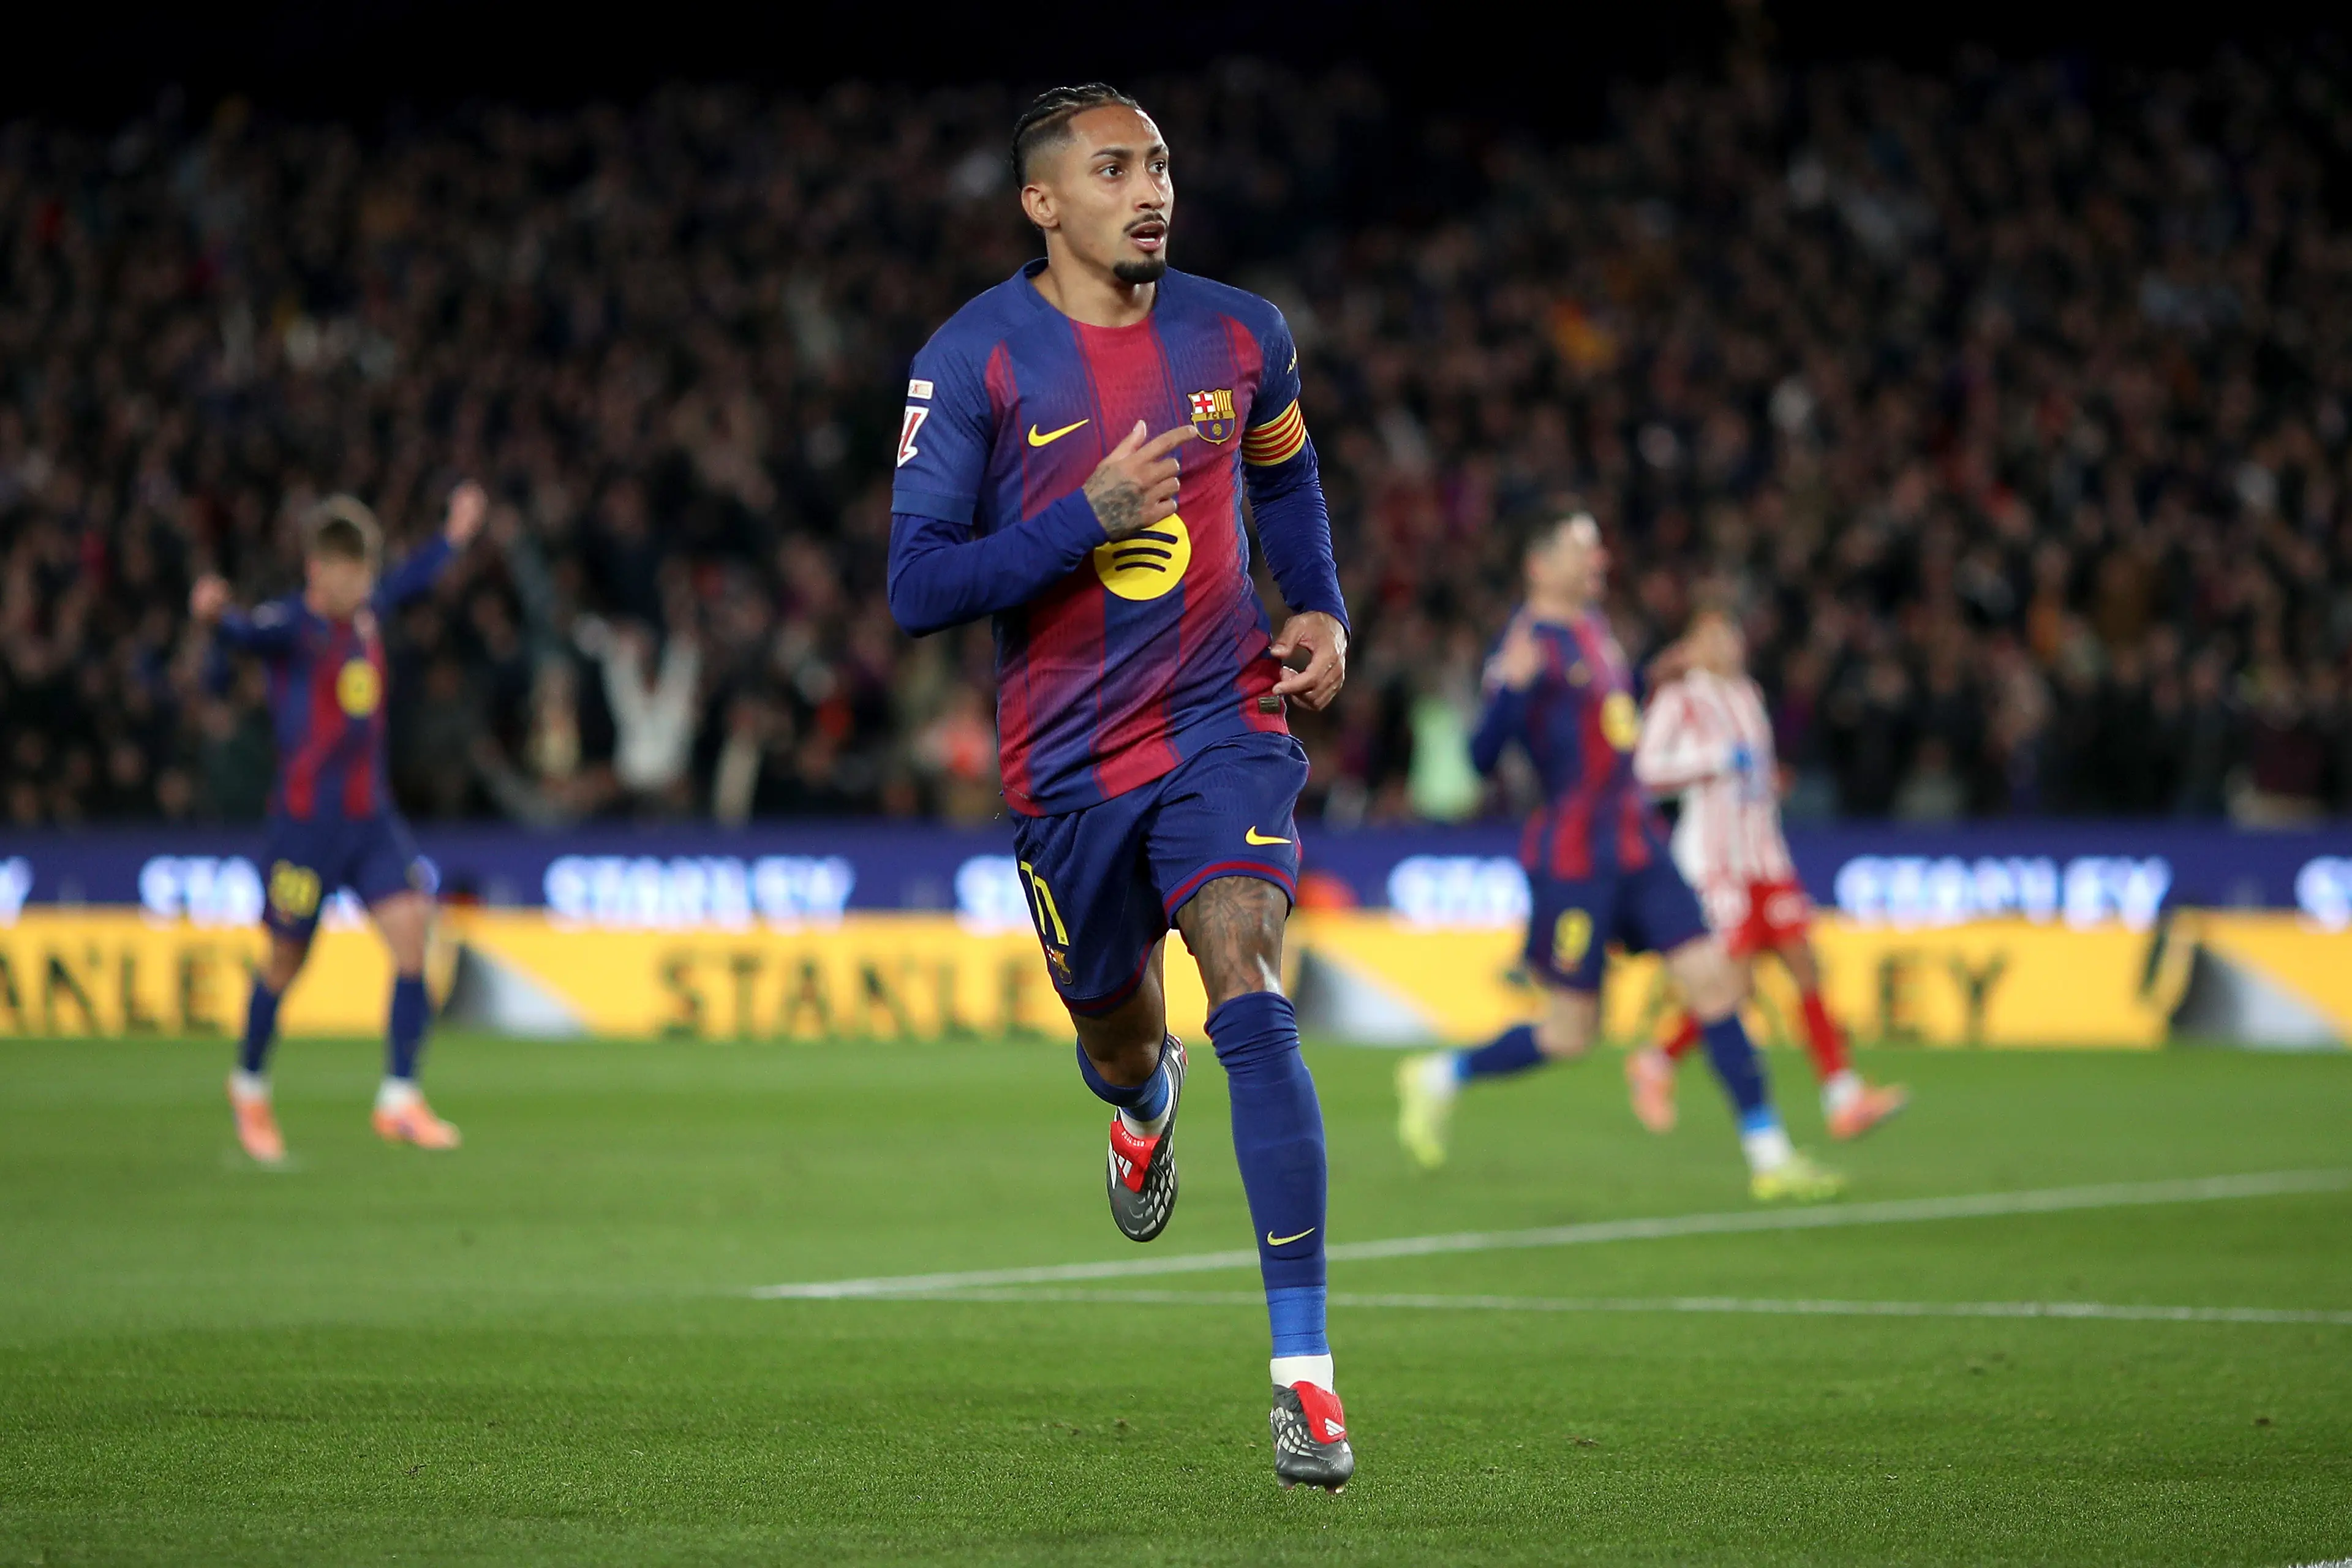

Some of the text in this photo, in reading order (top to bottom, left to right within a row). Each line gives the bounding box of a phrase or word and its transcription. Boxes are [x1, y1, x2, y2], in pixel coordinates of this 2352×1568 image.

[1205, 411, 1224, 420] FCB
[1020, 860, 1069, 946] 11
[657, 942, 1051, 1042] STANLE
